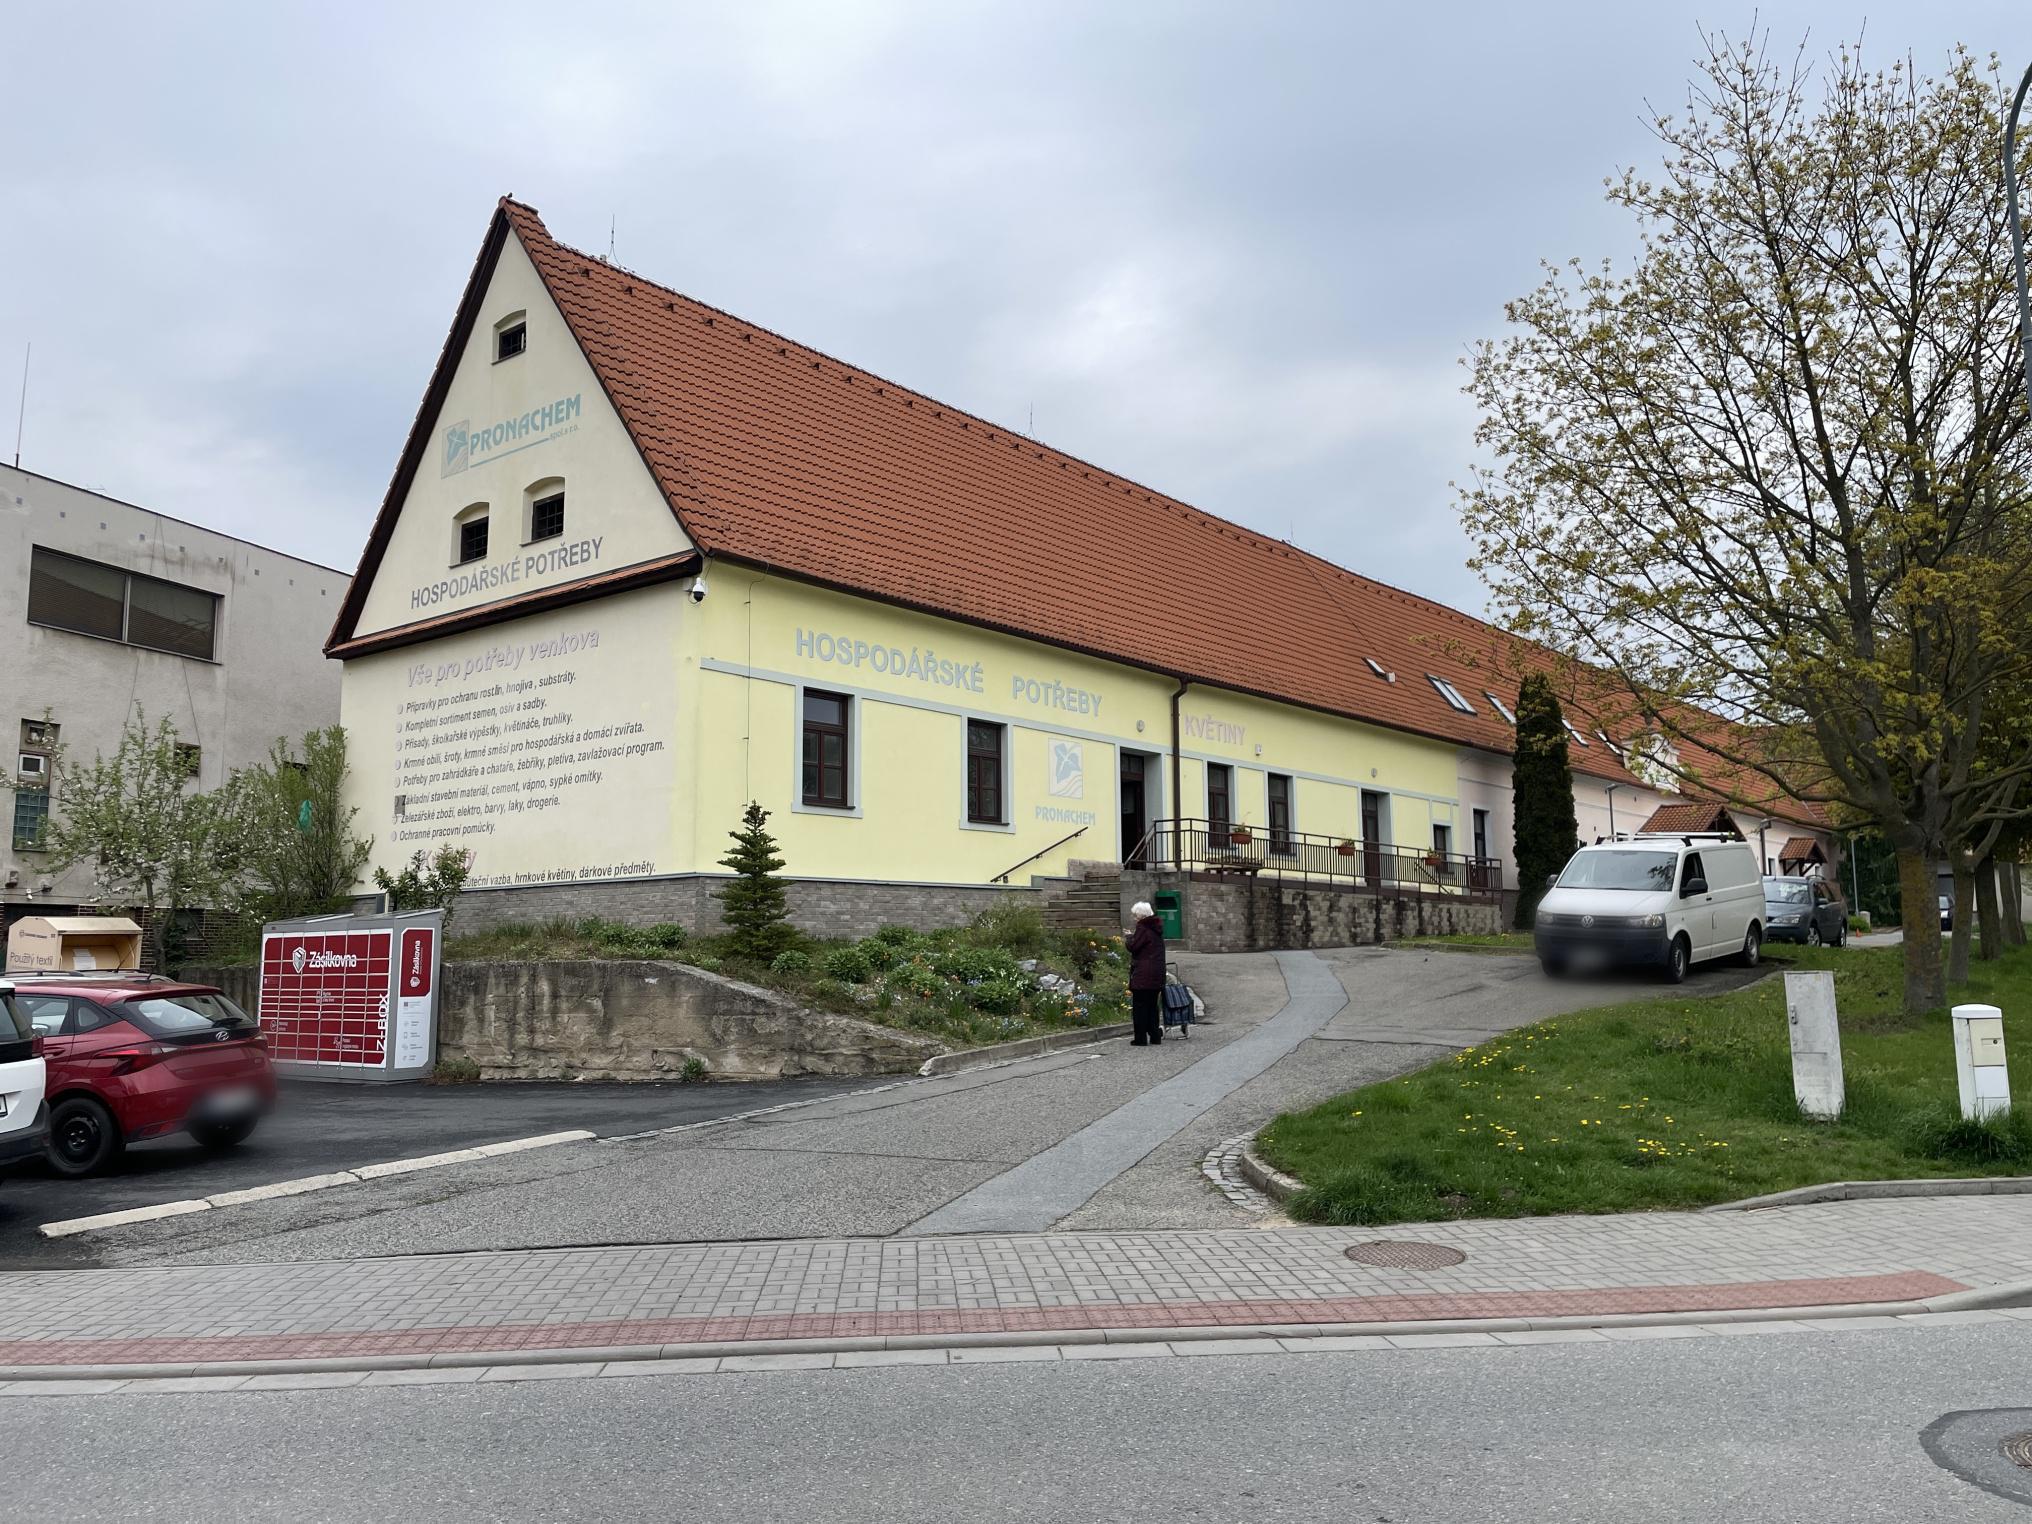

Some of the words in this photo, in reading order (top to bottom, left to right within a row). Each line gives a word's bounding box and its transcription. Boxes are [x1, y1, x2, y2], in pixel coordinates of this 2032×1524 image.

[470, 393, 581, 455] PRONACHEM
[411, 556, 520, 609] HOSPODÁŘSKÉ
[525, 537, 603, 578] POTŘEBY
[408, 664, 433, 688] Vše
[435, 660, 461, 687] pro
[464, 644, 526, 682] potřeby
[528, 628, 600, 661] venkova
[796, 628, 985, 694] HOSPODÁŘSKÉ
[1011, 675, 1103, 717] POTŘEBY
[406, 697, 436, 714] Přípravky
[438, 697, 450, 710] pro
[450, 692, 479, 704] ochranu
[538, 670, 576, 688] substráty.
[405, 716, 438, 733] Kompletní
[439, 712, 472, 726] sortiment
[472, 708, 498, 720] semen,
[499, 702, 514, 716] osiv
[516, 703, 521, 712] a
[522, 696, 548, 711] sadby.
[432, 728, 468, 746] školkařské
[469, 722, 502, 742] výpěstky,
[503, 718, 541, 734] květináče,
[542, 712, 574, 728] truhlíky.
[1184, 714, 1247, 746] KVĚTINY
[403, 756, 426, 769] Krmné
[444, 751, 462, 764] šroty,
[464, 745, 487, 760] krmné
[488, 742, 510, 757] směsí
[510, 742, 524, 755] pro
[525, 732, 574, 750] hospodářská
[576, 734, 581, 742] a
[582, 725, 614, 742] domácí
[614, 720, 645, 737] zvířata.
[403, 772, 428, 787] Potřeby
[428, 772, 440, 786] pro
[442, 765, 480, 781] zahrádkáře
[480, 766, 485, 776] a
[486, 760, 515, 775] chataře,
[517, 756, 546, 772] žebříky,
[548, 752, 577, 768] pletiva,
[578, 744, 625, 762] zavlažovací
[626, 740, 665, 758] program.
[430, 788, 459, 802] stavební
[460, 784, 490, 799] materiál,
[492, 781, 520, 795] cement,
[522, 778, 548, 793] vápno,
[550, 772, 573, 790] sypké
[574, 770, 604, 784] omítky.
[436, 806, 456, 820] zboží,
[457, 803, 483, 818] elektro,
[484, 802, 506, 816] barvy,
[508, 798, 526, 813] laky,
[527, 794, 561, 810] drogerie.
[1035, 805, 1096, 826] PRONACHEM
[400, 828, 431, 841] Ochranné
[431, 824, 462, 840] pracovní
[490, 875, 514, 887] vazba,
[514, 869, 546, 884] hrnkové
[548, 867, 578, 882] květiny,
[579, 863, 613, 878] dárkové
[614, 860, 656, 878] předměty.
[10, 952, 34, 966] Použitý
[36, 954, 54, 966] textil
[309, 950, 357, 969] Zásilkovna
[412, 940, 421, 975] Zásilkovna
[376, 993, 389, 1052] Z-BOX
